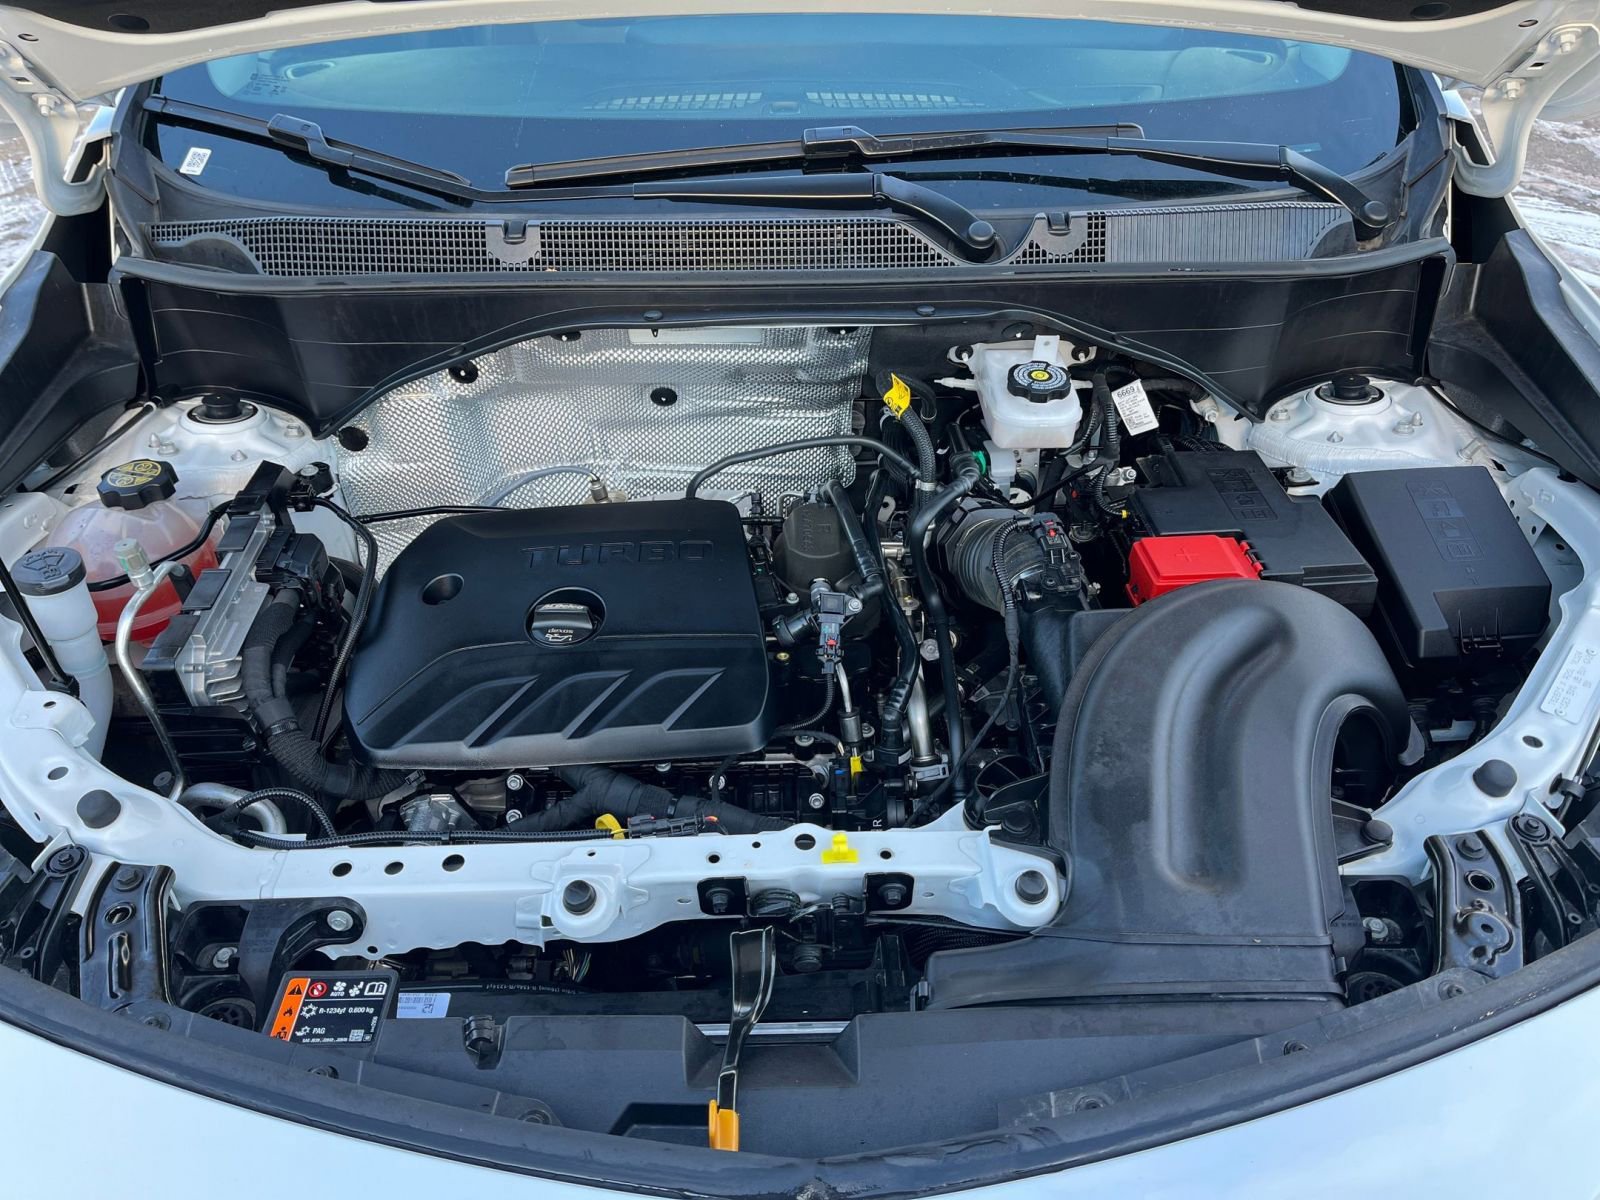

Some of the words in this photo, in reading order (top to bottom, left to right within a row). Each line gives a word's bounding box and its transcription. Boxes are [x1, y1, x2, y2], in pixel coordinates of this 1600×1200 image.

[1117, 386, 1135, 398] 6669
[522, 540, 714, 568] TURBO
[318, 1007, 346, 1015] R-1234yf
[365, 1006, 374, 1014] kg
